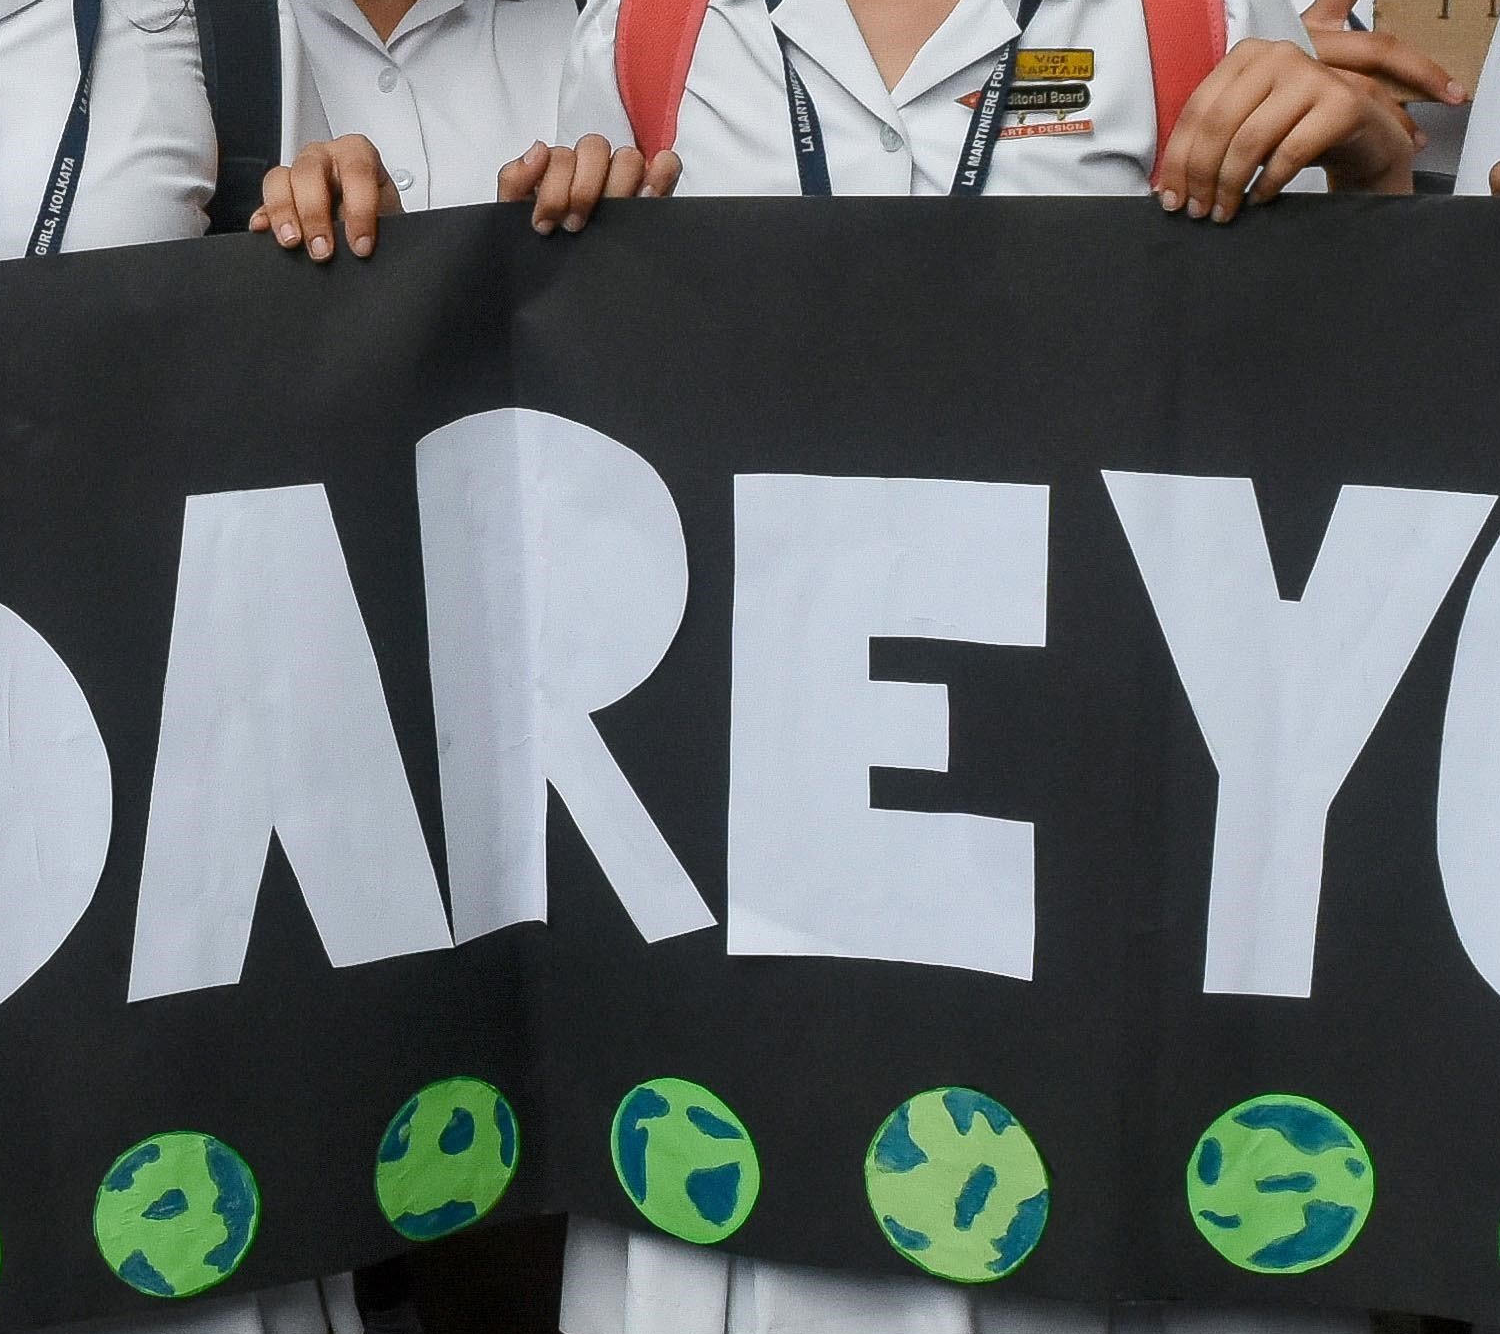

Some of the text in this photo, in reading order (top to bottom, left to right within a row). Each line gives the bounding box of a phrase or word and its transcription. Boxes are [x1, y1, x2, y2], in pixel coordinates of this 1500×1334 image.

[1033, 54, 1070, 65] VICE
[990, 62, 1007, 87] FOR
[1007, 90, 1085, 106] ditorial Board
[966, 90, 1000, 168] MARTINIERE
[1000, 127, 1023, 137] ART
[1038, 122, 1085, 134] DESIGN
[801, 135, 815, 153] LA
[961, 169, 978, 186] LA
[35, 156, 76, 256] GIRLS, KOLKATA
